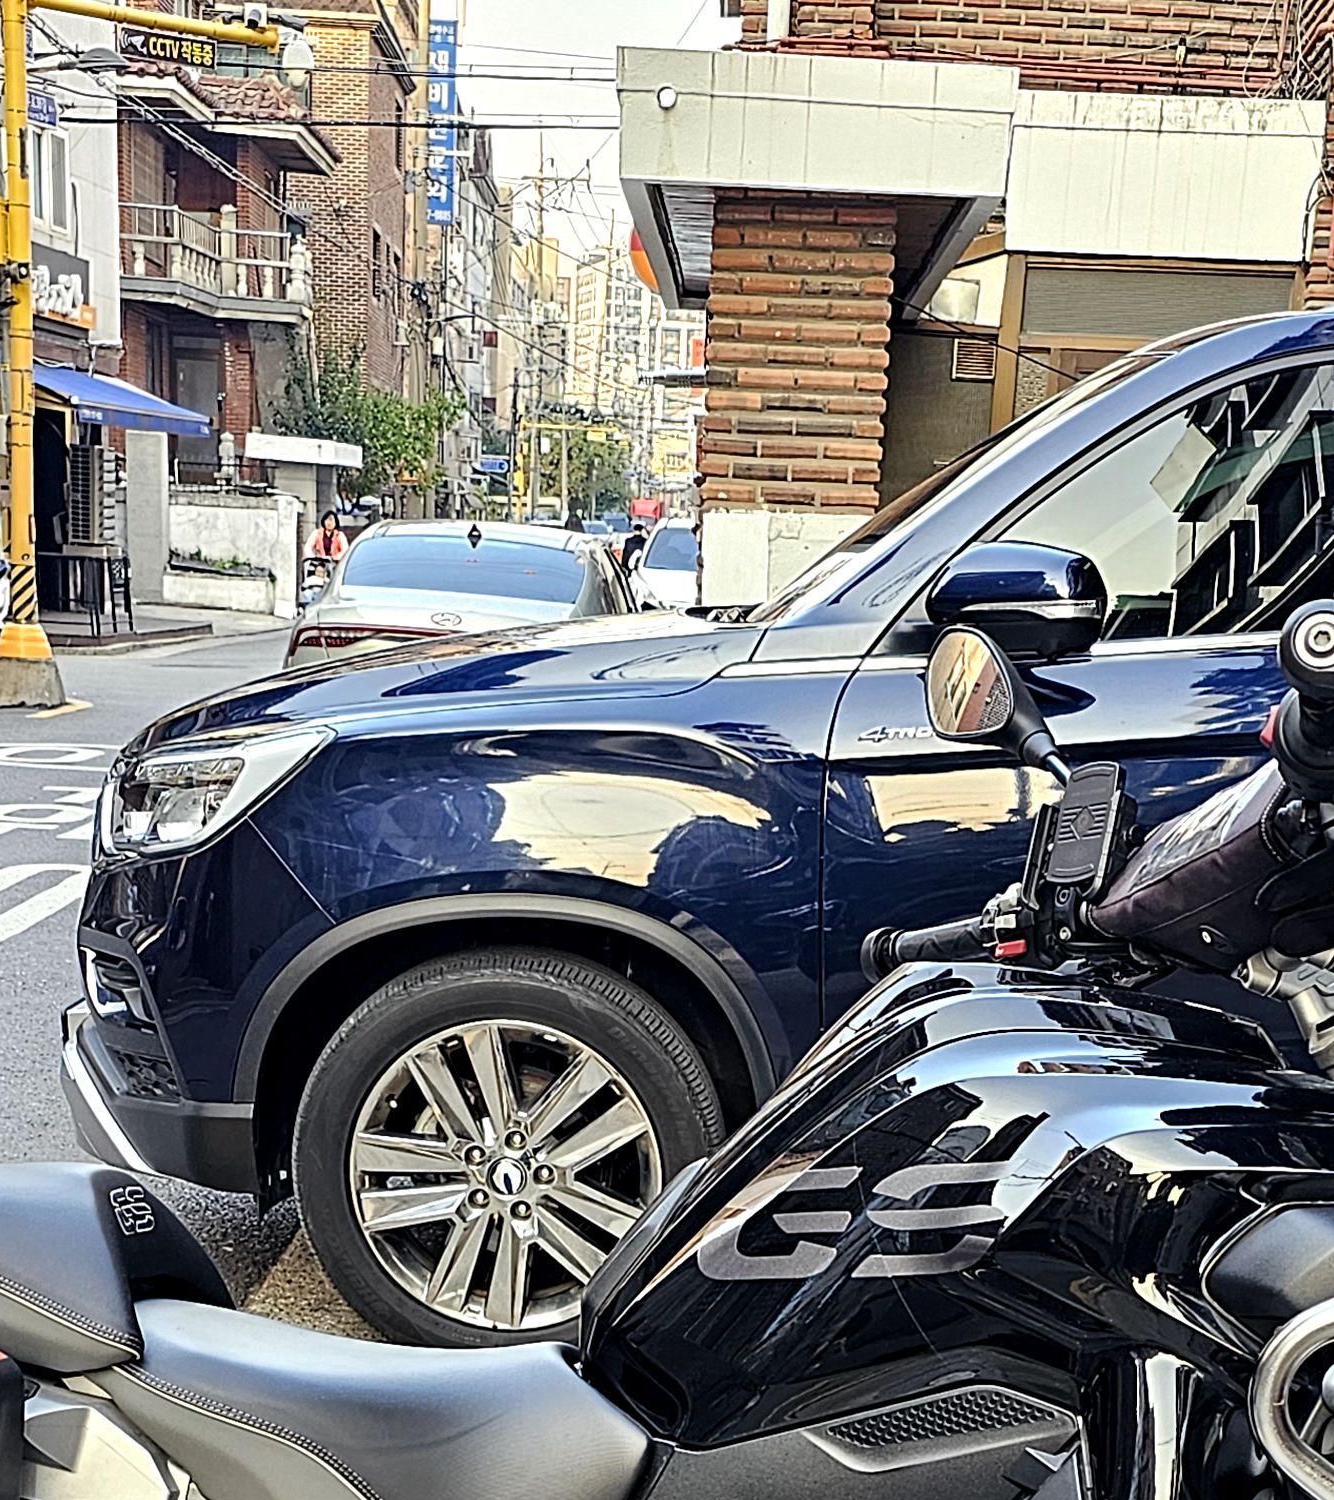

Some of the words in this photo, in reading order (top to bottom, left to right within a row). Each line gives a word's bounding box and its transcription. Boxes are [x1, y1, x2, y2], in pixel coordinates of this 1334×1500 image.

[149, 36, 179, 59] CCTV
[180, 41, 214, 66] 작동중
[698, 1159, 1013, 1281] GS
